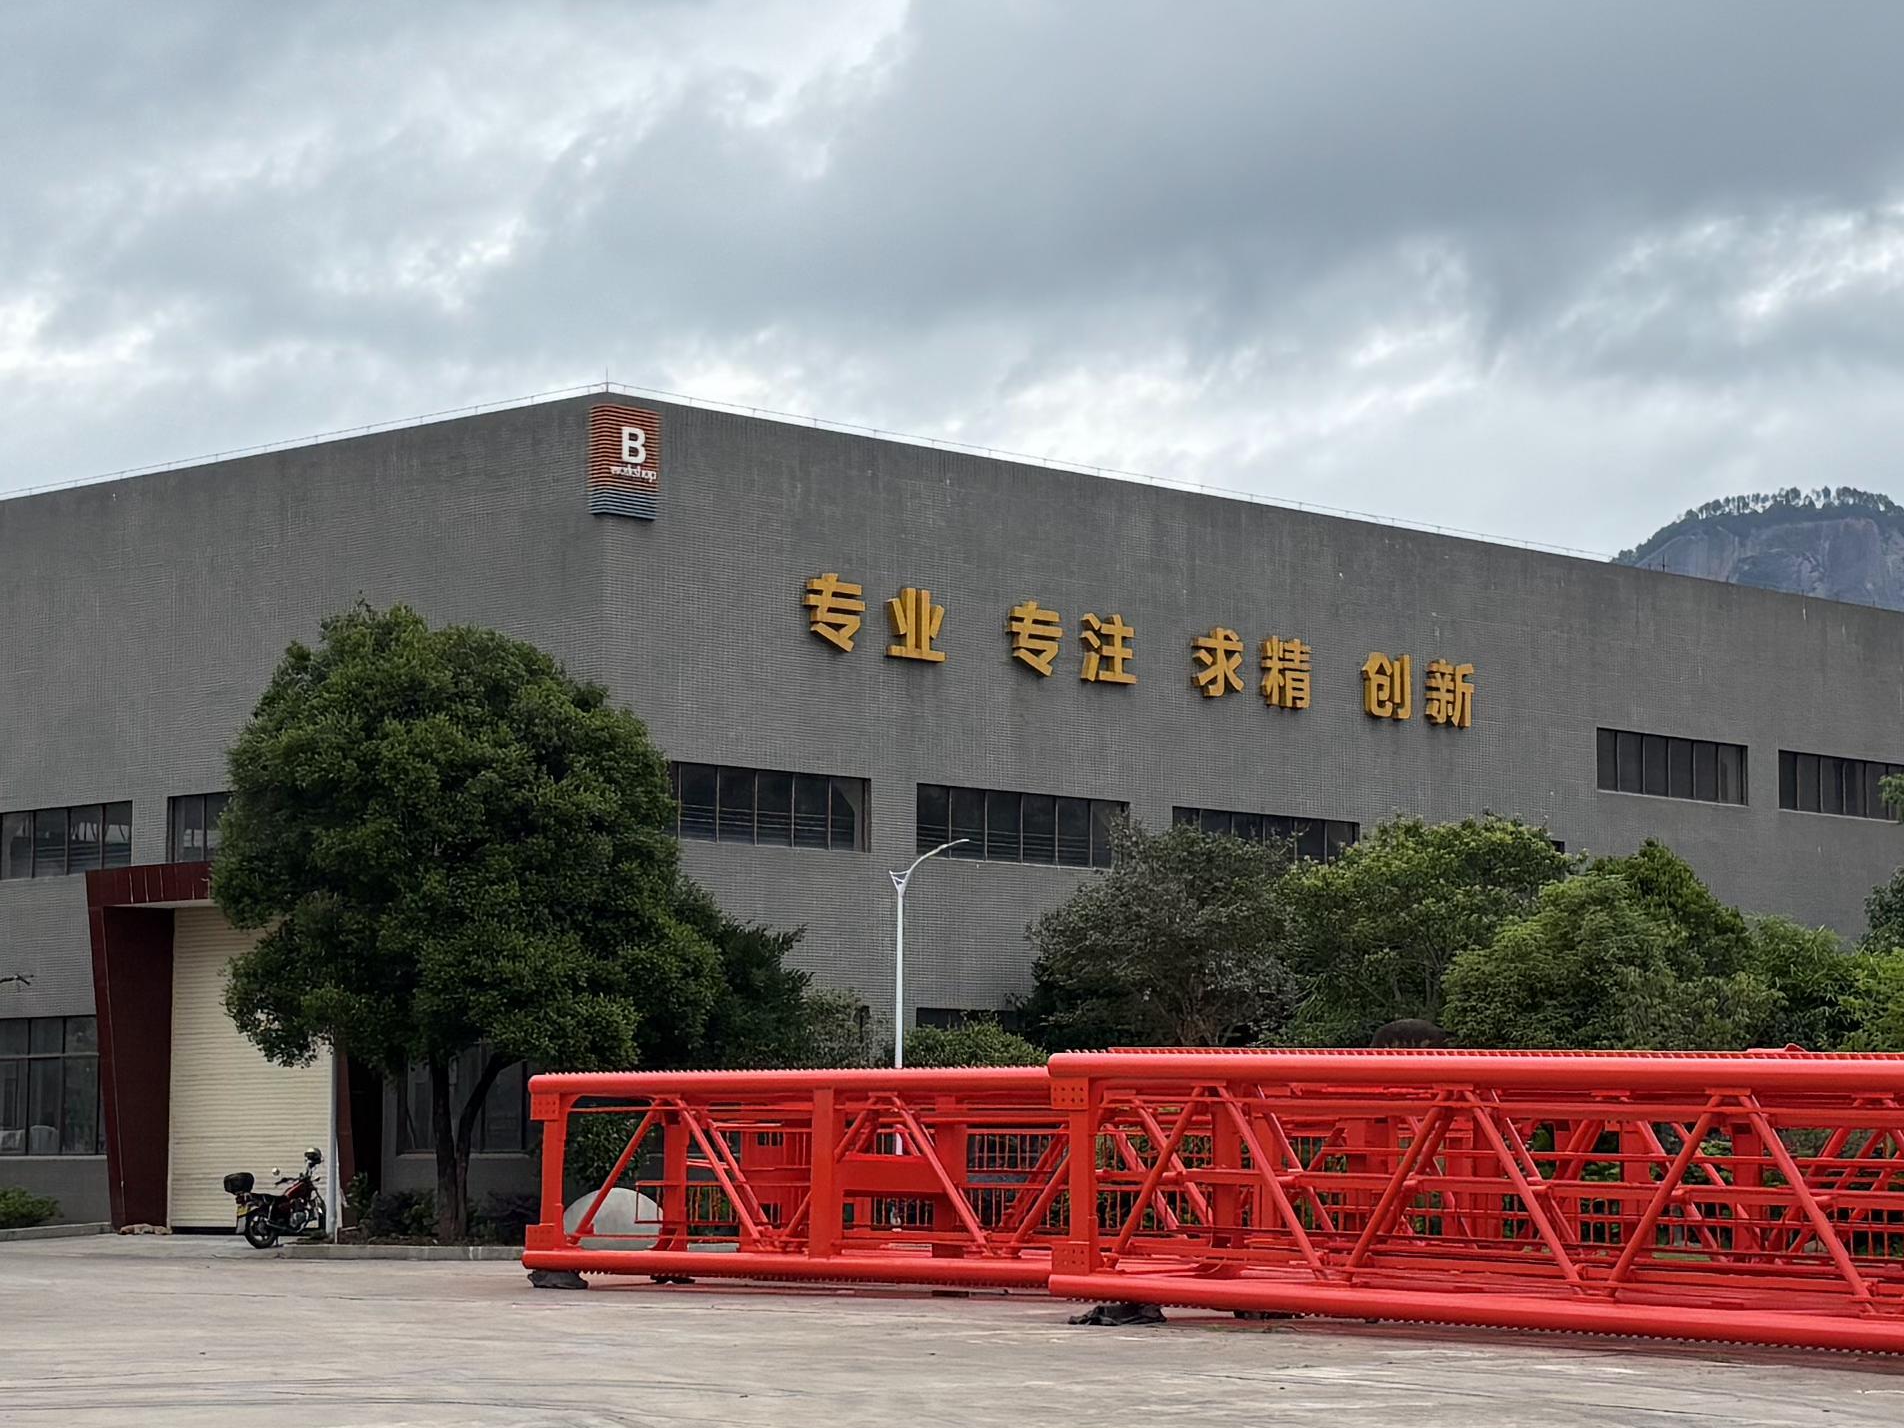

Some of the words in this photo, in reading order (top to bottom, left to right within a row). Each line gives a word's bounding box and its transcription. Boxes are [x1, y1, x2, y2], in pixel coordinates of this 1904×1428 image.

[621, 426, 648, 464] B
[802, 572, 947, 663] 专业
[1006, 599, 1138, 685] 专注
[1192, 626, 1313, 711] 求精
[1361, 652, 1475, 728] 创新
